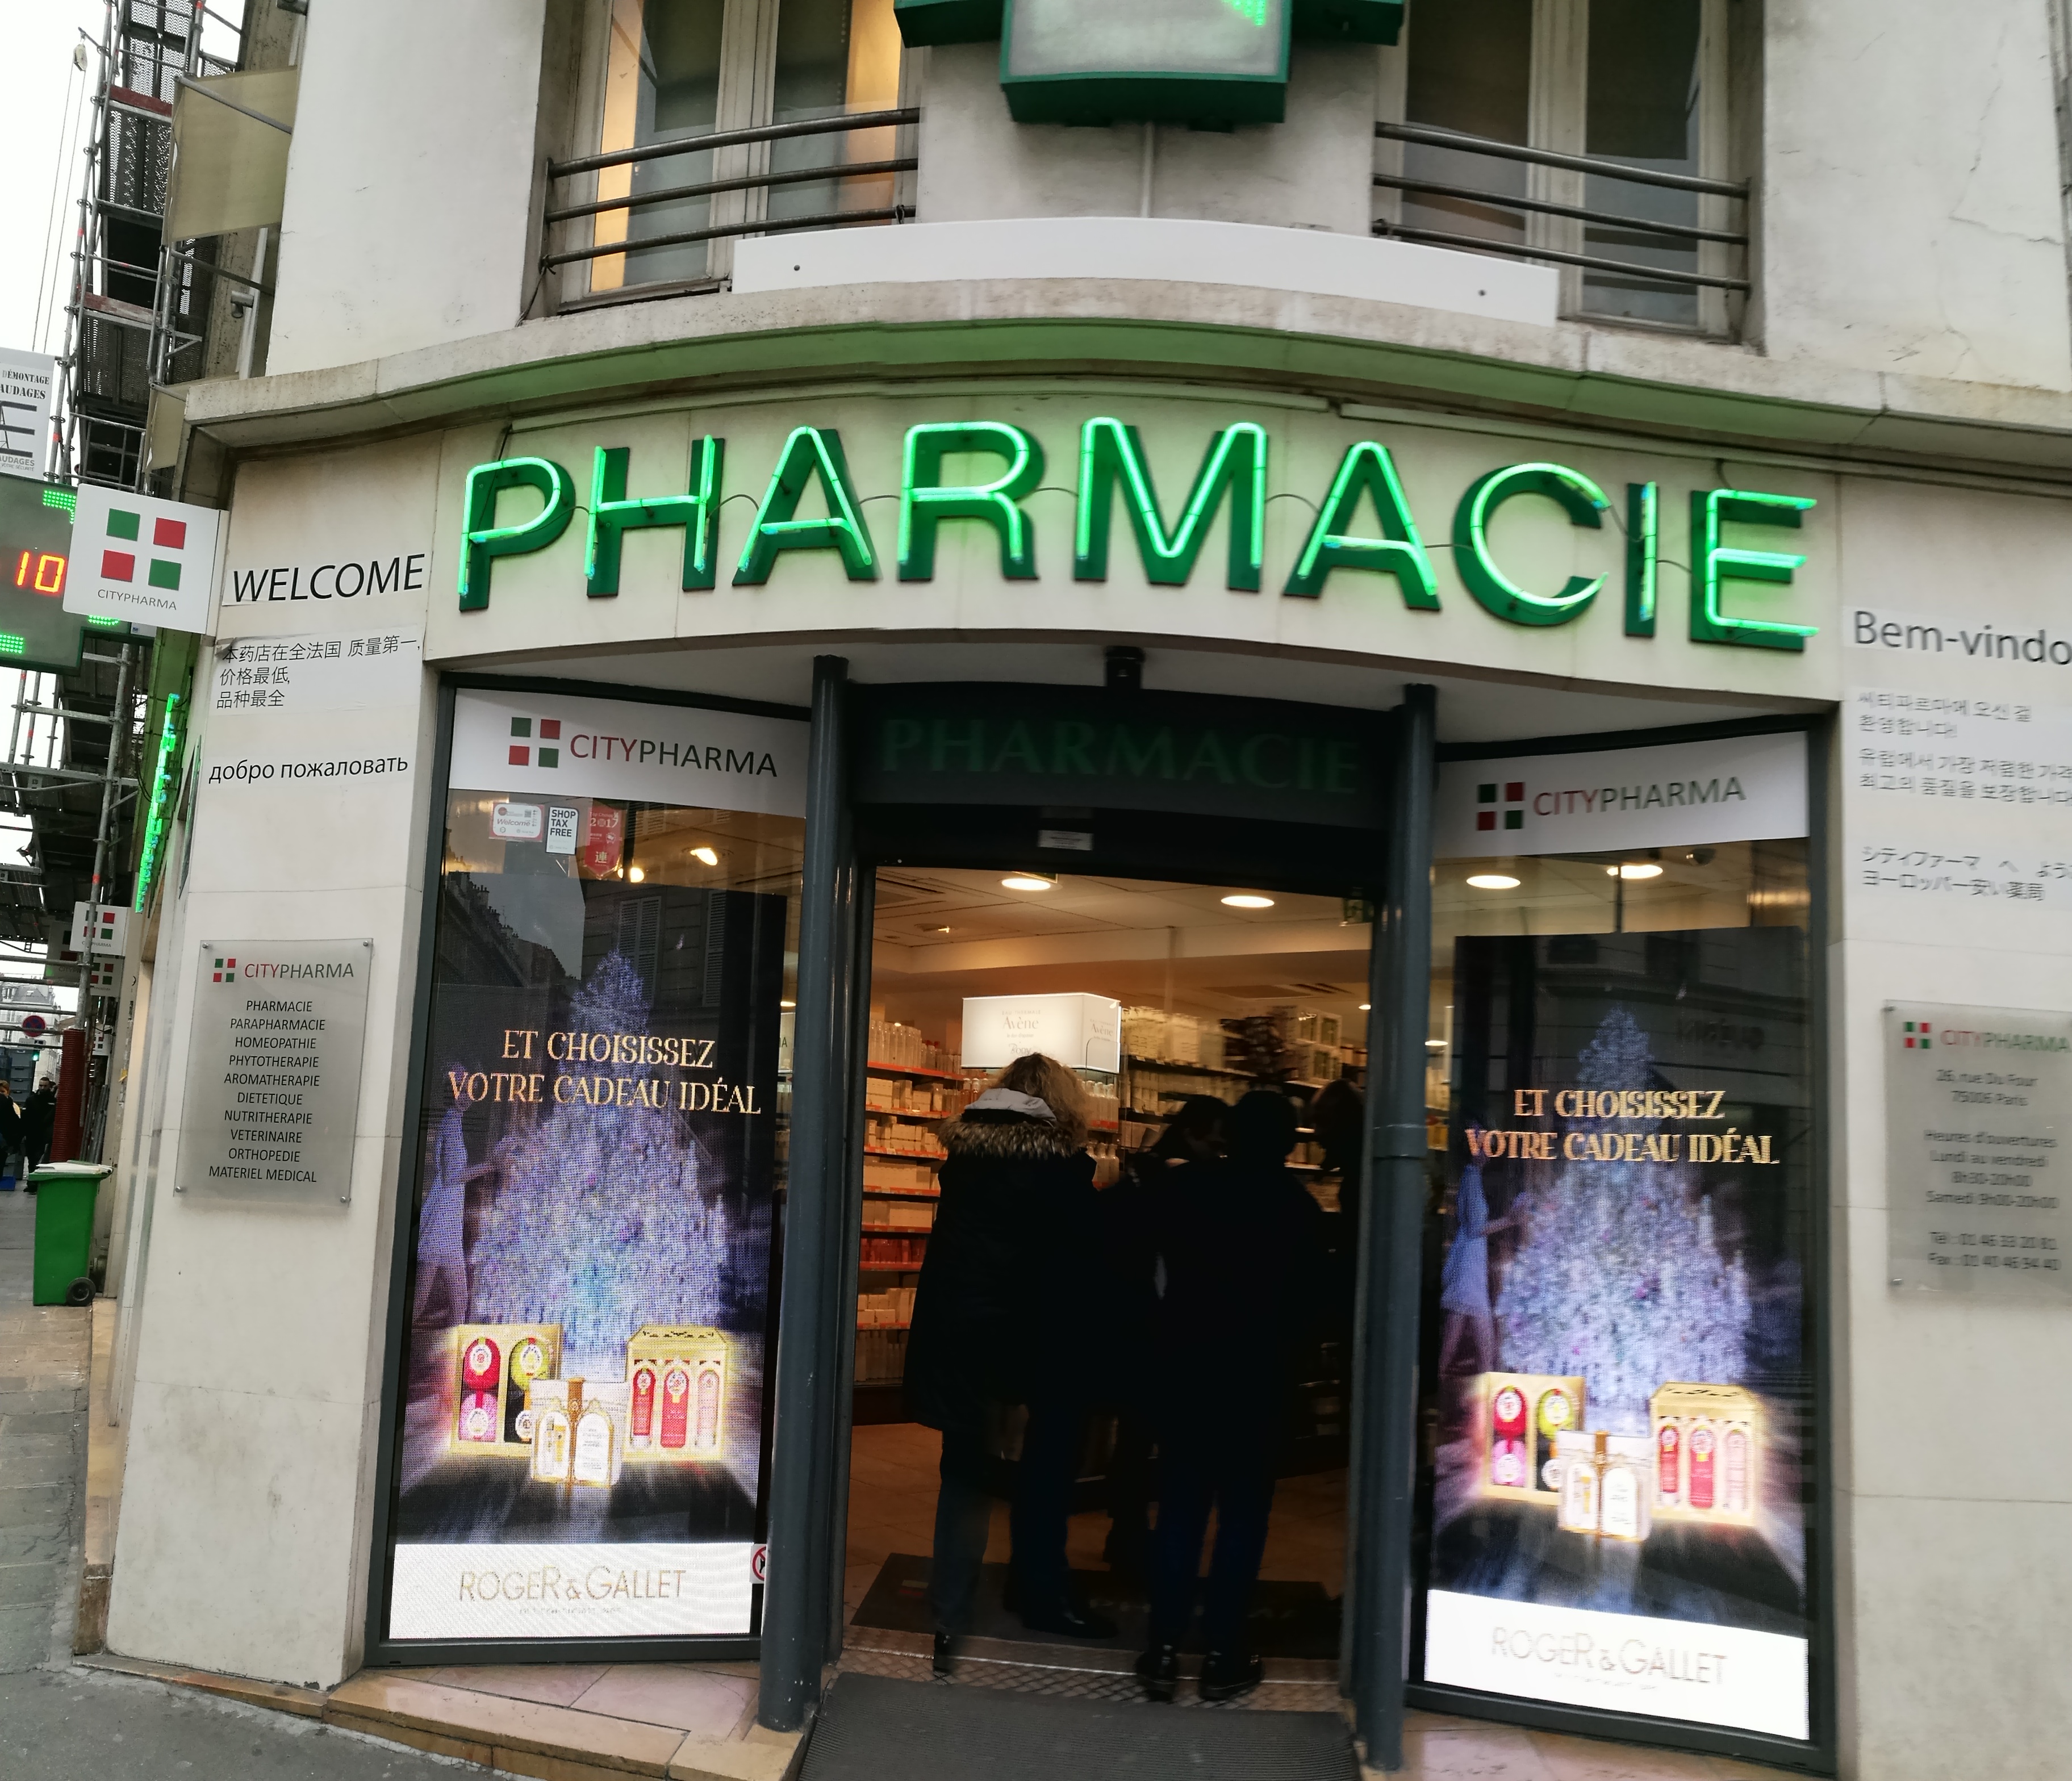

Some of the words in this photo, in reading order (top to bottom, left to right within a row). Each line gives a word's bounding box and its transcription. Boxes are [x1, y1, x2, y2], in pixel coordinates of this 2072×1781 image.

[2, 369, 49, 384] DÉMONTAGE
[458, 417, 1818, 651] PHARMACIE
[17, 551, 65, 592] 10
[233, 554, 425, 602] WELCOME
[98, 589, 177, 611] CITYPHARMA
[1854, 610, 2072, 665] Bem-vindo
[222, 641, 341, 664] 本药店在全法国
[216, 689, 285, 709] 品种最全
[570, 734, 778, 777] CITYPHARMA
[882, 718, 1359, 794] PHARMACIE
[208, 759, 274, 784] добро
[281, 757, 408, 779] пожаловать
[1534, 777, 1747, 816] CITYPHARMA
[552, 809, 576, 818] SHOP
[551, 818, 568, 827] TAX
[550, 828, 572, 837] FREE
[244, 963, 354, 979] CITYPHARMA
[246, 1000, 313, 1013] PHARMACIE
[230, 1018, 325, 1031] PARAPHARMACIE
[1003, 1016, 1039, 1029] Avène
[235, 1036, 316, 1050] HOMEOPATHIE
[502, 1030, 538, 1059] ET
[547, 1032, 716, 1068] CHOISISSEZ
[229, 1055, 319, 1068] PHYTOTHERAPIE
[224, 1073, 320, 1086] AROMATHERAPIE
[237, 1092, 303, 1105] DIETETIQUE
[448, 1071, 545, 1103] VOTRE
[554, 1075, 670, 1109] CADEAU
[680, 1077, 761, 1114] IDÉAL
[1514, 1089, 1549, 1116] ET
[1555, 1090, 1726, 1119] CHOISISSEZ
[224, 1110, 312, 1124] NUTRITHERAPIE
[231, 1129, 303, 1143] VETERINAIRE
[1465, 1128, 1558, 1160] VOTRE
[1563, 1132, 1682, 1162] CADEAU
[1687, 1127, 1781, 1164] IDÉAL
[228, 1148, 300, 1163] ORTHOPEDIE
[209, 1166, 262, 1180] MATERIEL
[266, 1168, 317, 1183] MEDICAL
